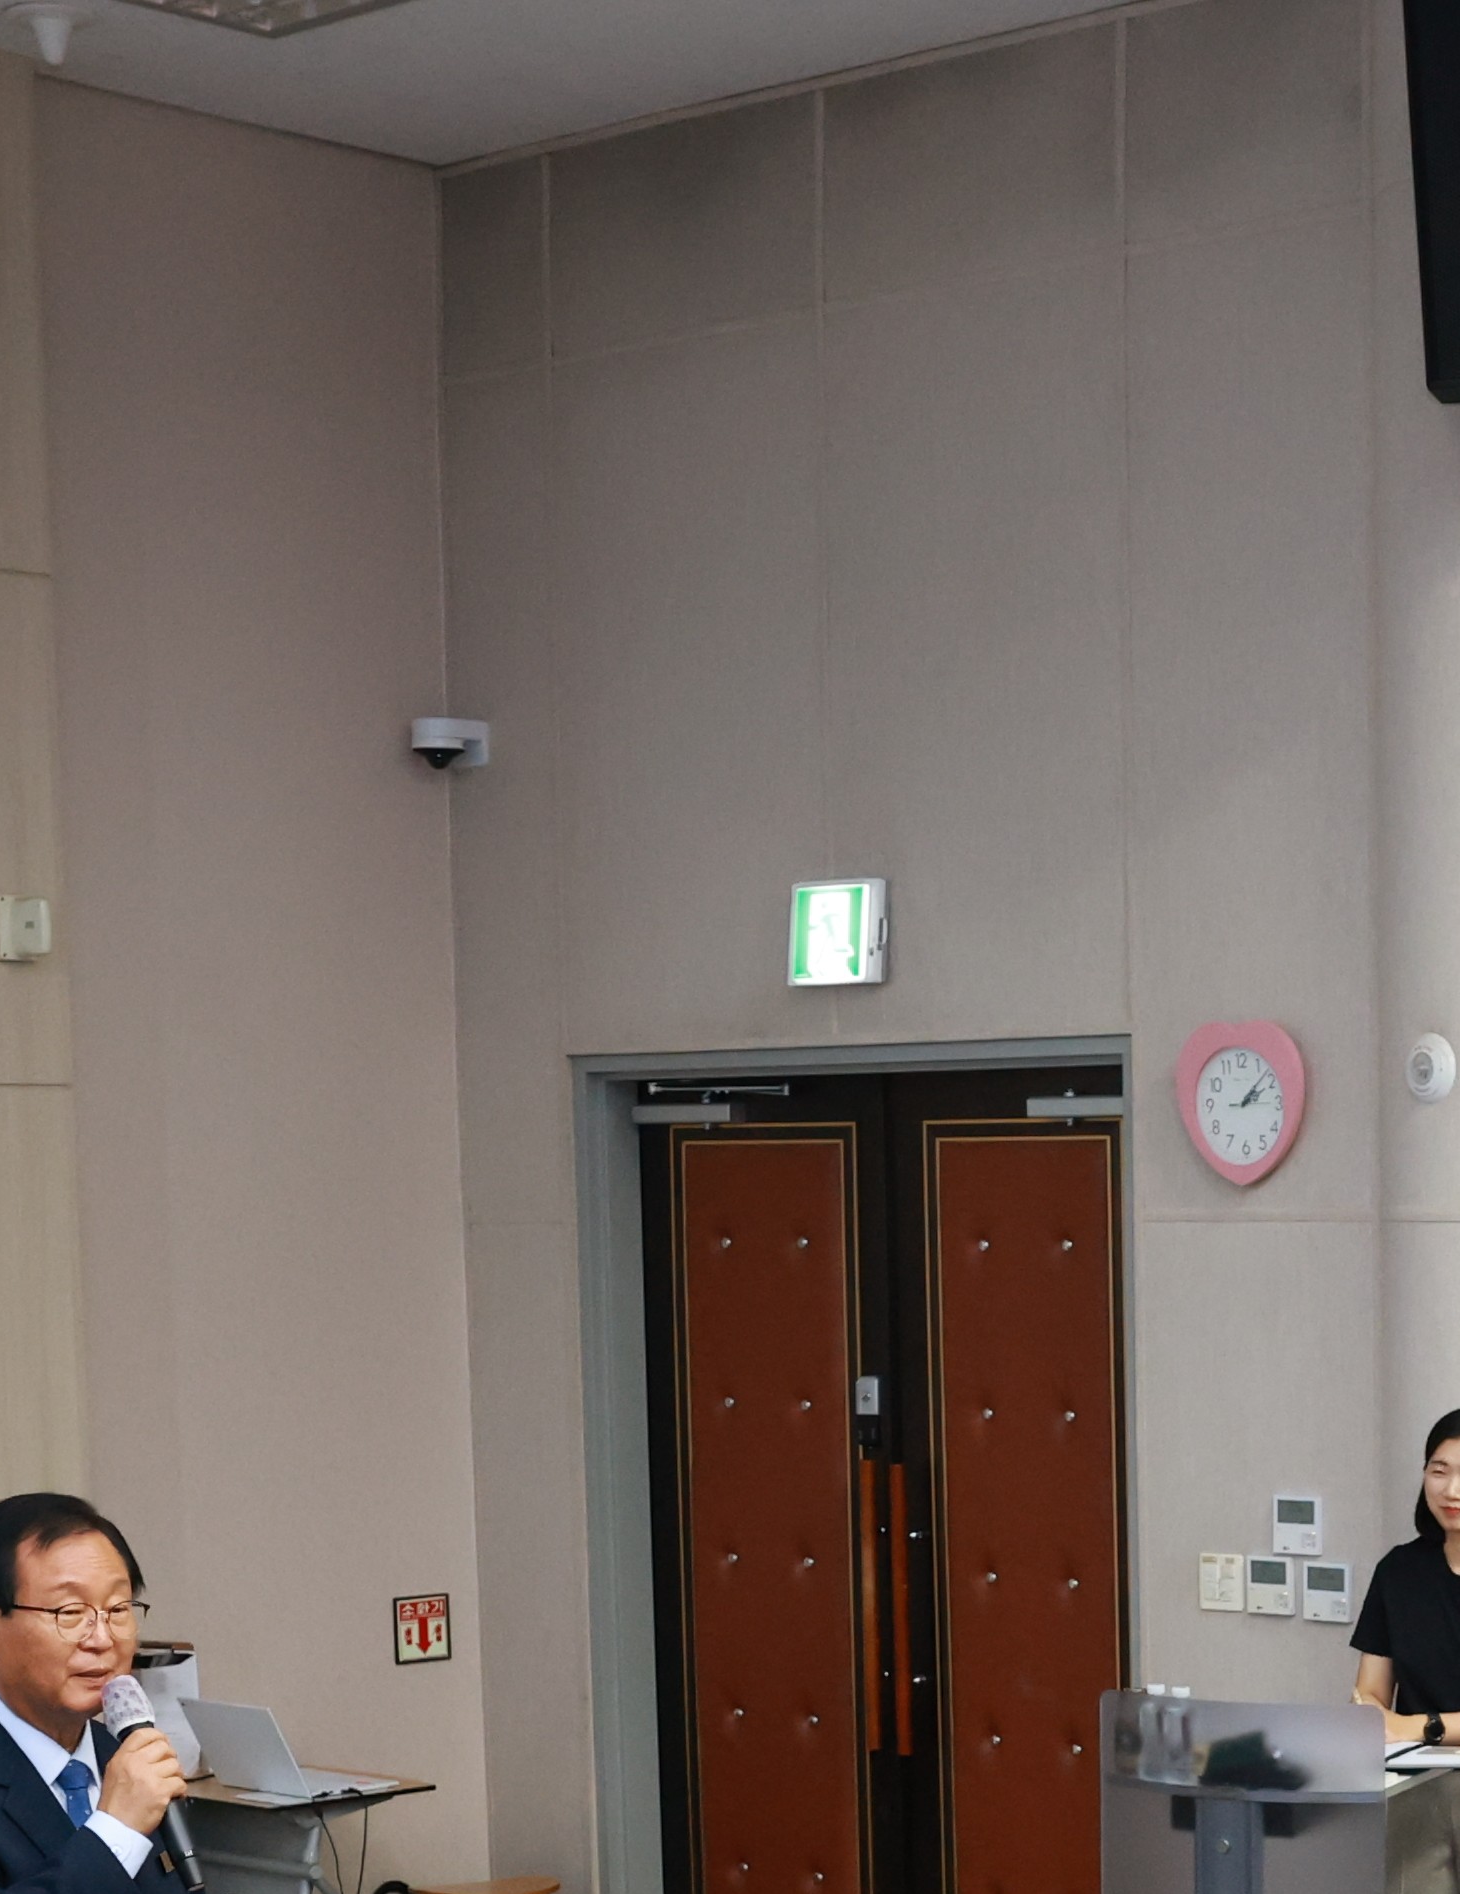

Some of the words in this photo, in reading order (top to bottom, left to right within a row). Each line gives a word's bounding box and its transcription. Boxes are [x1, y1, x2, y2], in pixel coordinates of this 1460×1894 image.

[1221, 1059, 1232, 1075] 11
[1235, 1052, 1248, 1069] 12
[1210, 1076, 1222, 1093] 10
[1267, 1073, 1276, 1090] 2
[1205, 1097, 1215, 1114] 9
[1274, 1094, 1283, 1111] 3
[1212, 1118, 1220, 1135] 8
[1269, 1120, 1278, 1133] 4
[1226, 1133, 1235, 1150] 7
[1241, 1139, 1251, 1156] 6
[1258, 1134, 1267, 1151] 5
[401, 1600, 444, 1617] 소화기
